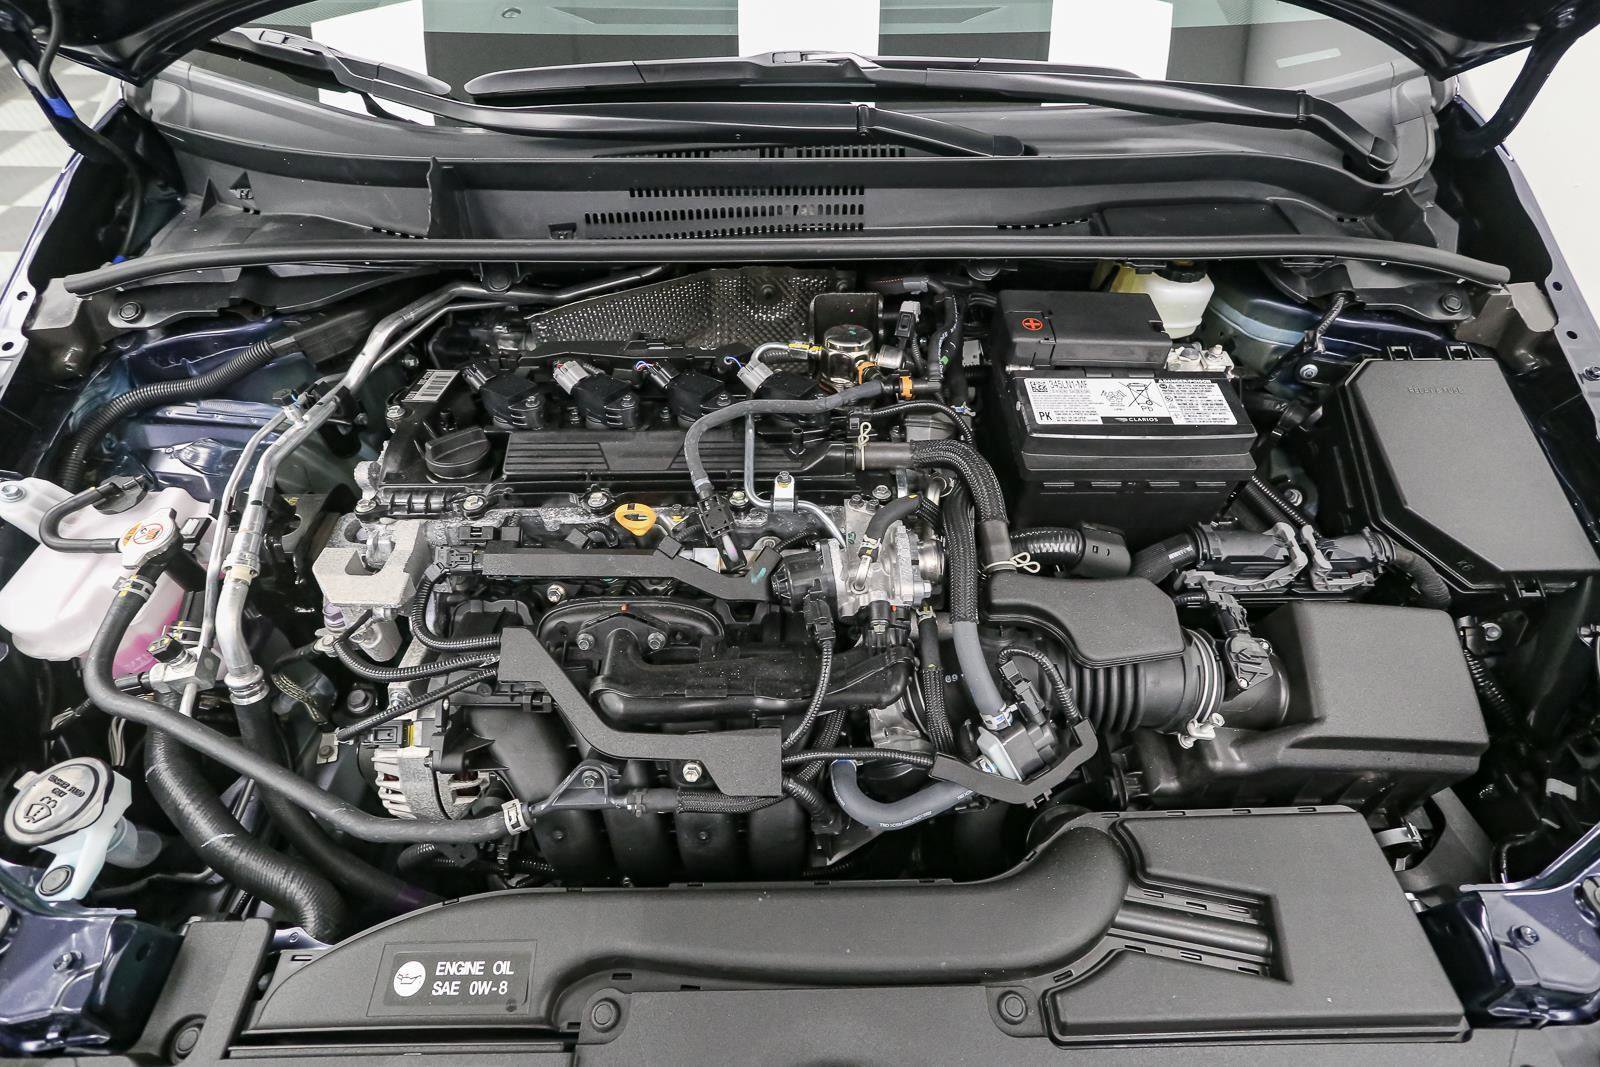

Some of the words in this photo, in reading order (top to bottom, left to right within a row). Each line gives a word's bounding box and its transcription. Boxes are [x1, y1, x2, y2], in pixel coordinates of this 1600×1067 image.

[1039, 411, 1052, 421] PK
[435, 961, 485, 976] ENGINE
[492, 961, 515, 975] OIL
[431, 981, 461, 995] SAE
[469, 980, 508, 995] 0W-8
